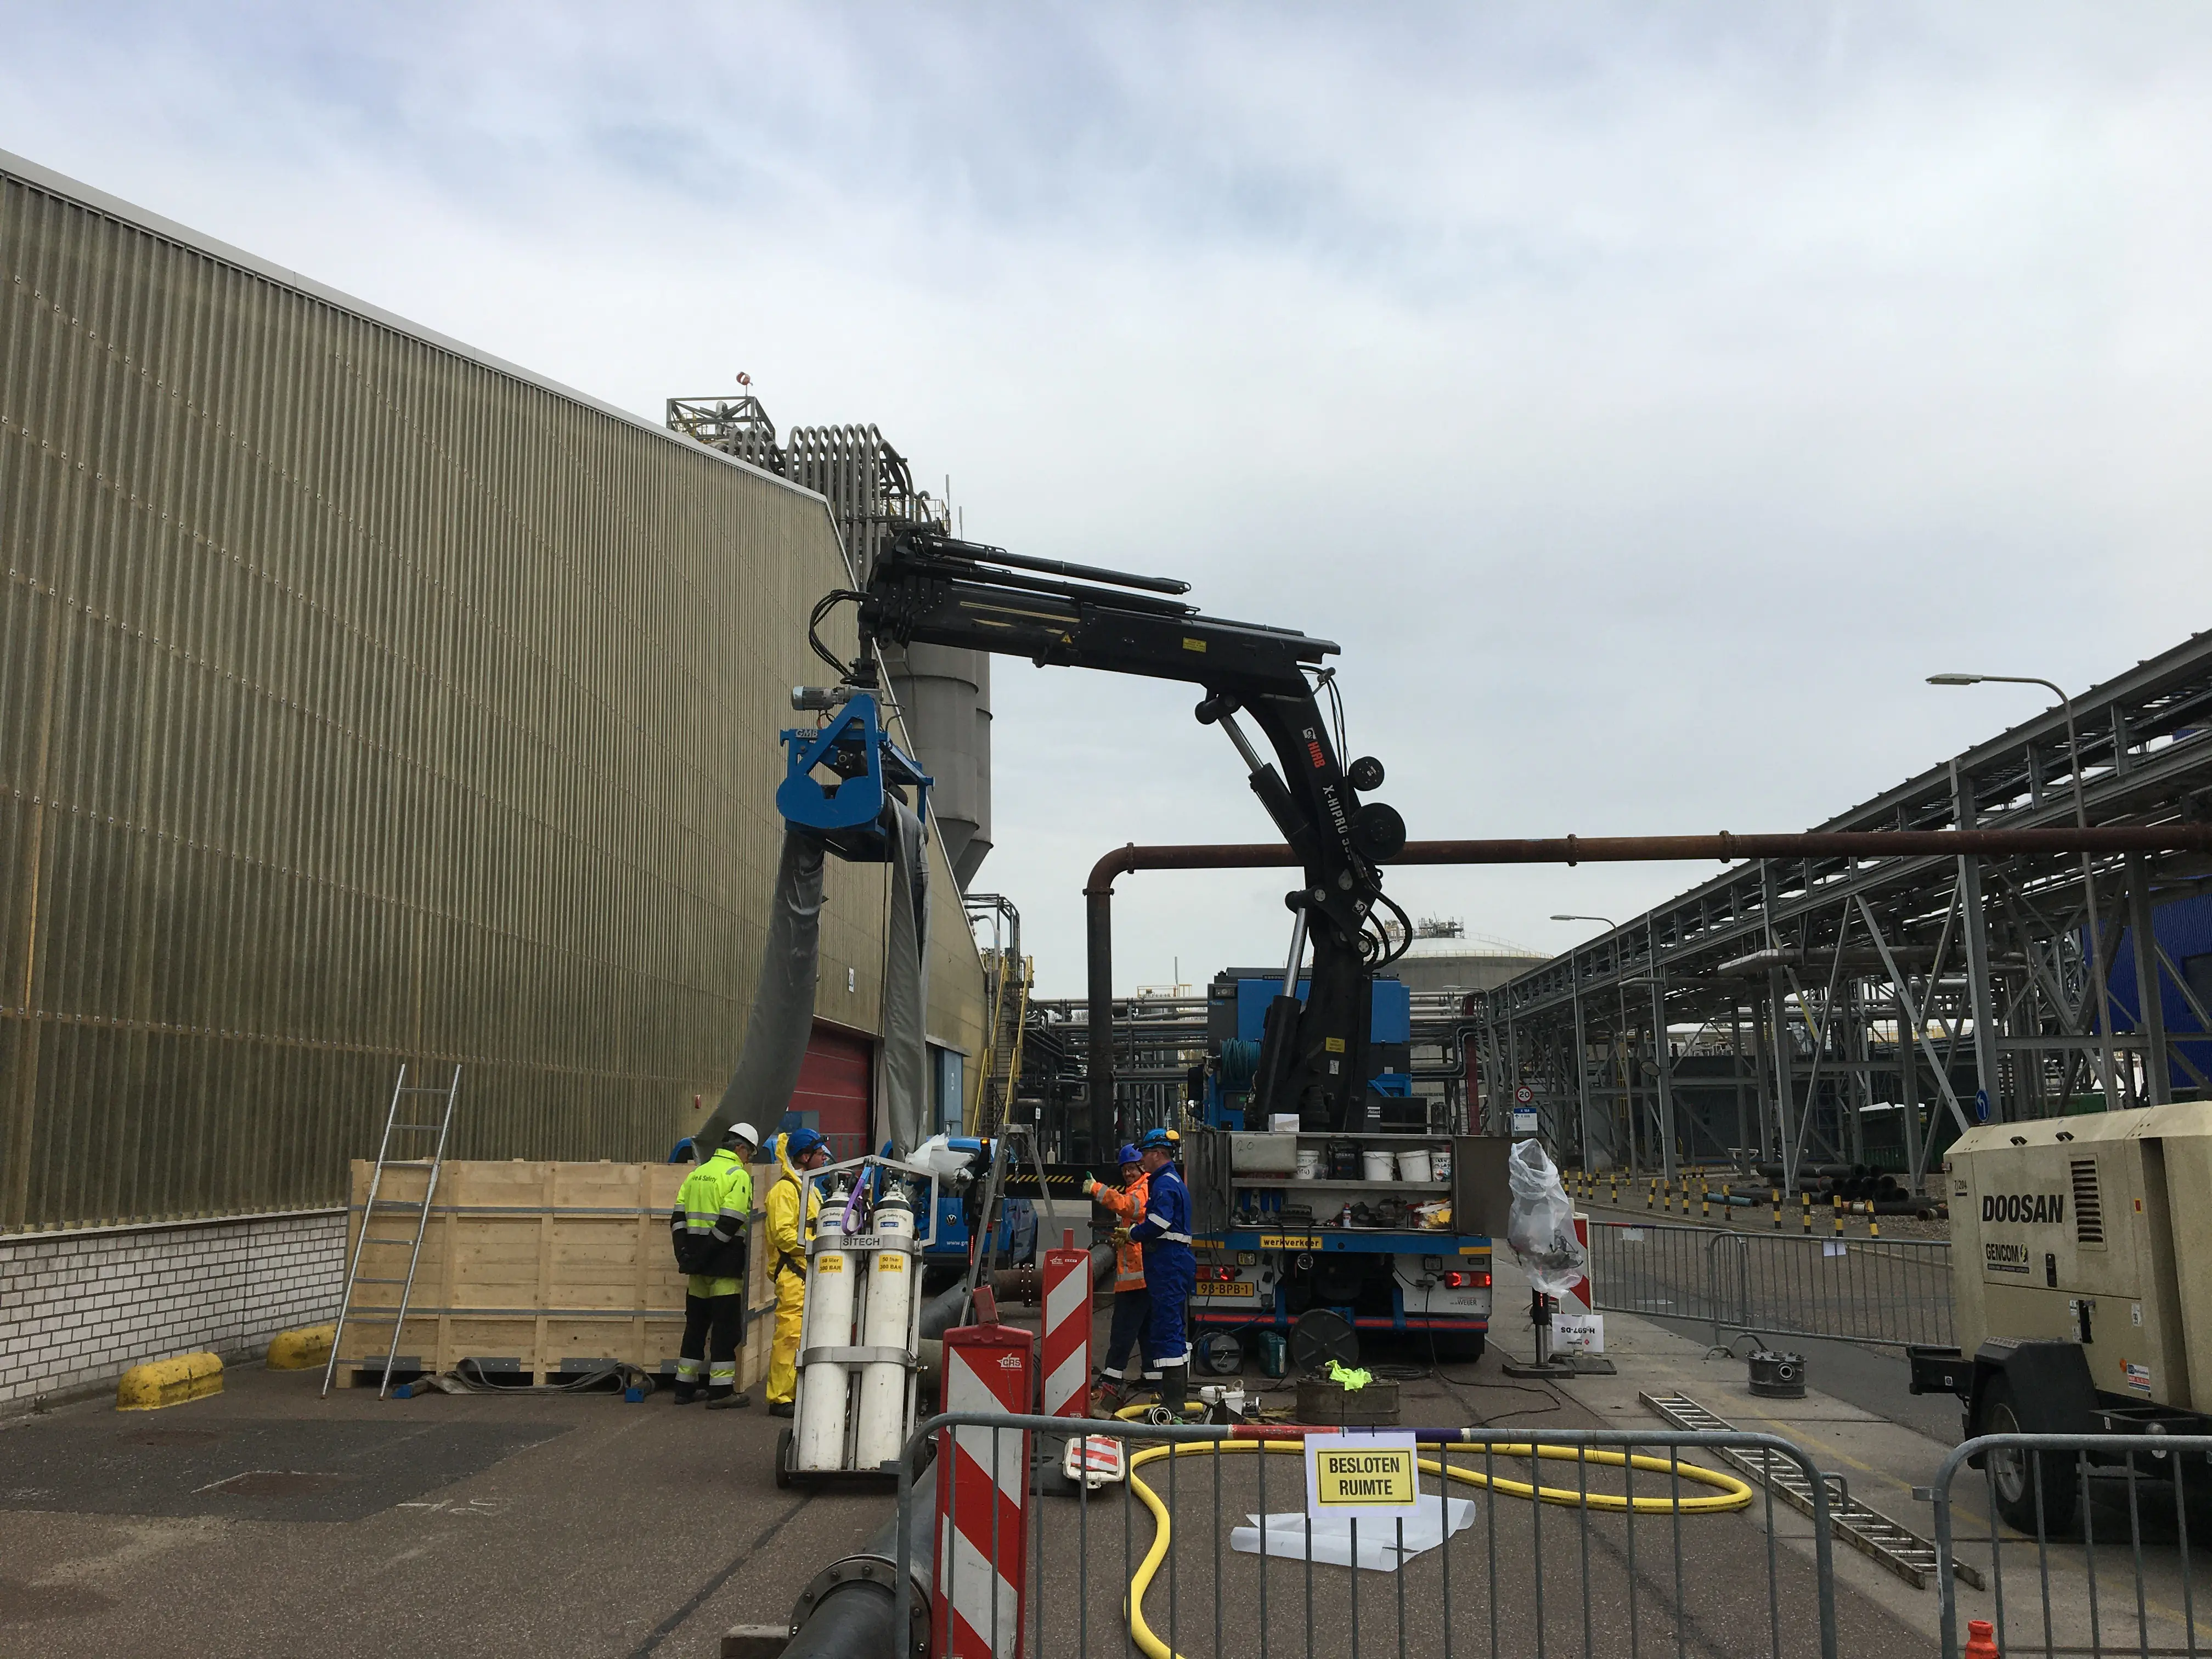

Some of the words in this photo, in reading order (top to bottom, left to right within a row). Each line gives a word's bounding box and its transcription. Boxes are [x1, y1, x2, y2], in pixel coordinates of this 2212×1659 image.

[796, 729, 817, 737] GMB
[1308, 742, 1325, 768] HIAB
[1323, 785, 1347, 834] X-HIPRO
[702, 1175, 718, 1183] Safety
[1982, 1194, 2064, 1223] DOOSAN
[843, 1238, 880, 1246] SITECH
[1986, 1243, 2019, 1262] GENCOM
[1329, 1457, 1400, 1473] BESLOTEN
[1339, 1479, 1393, 1496] RUIMTE
